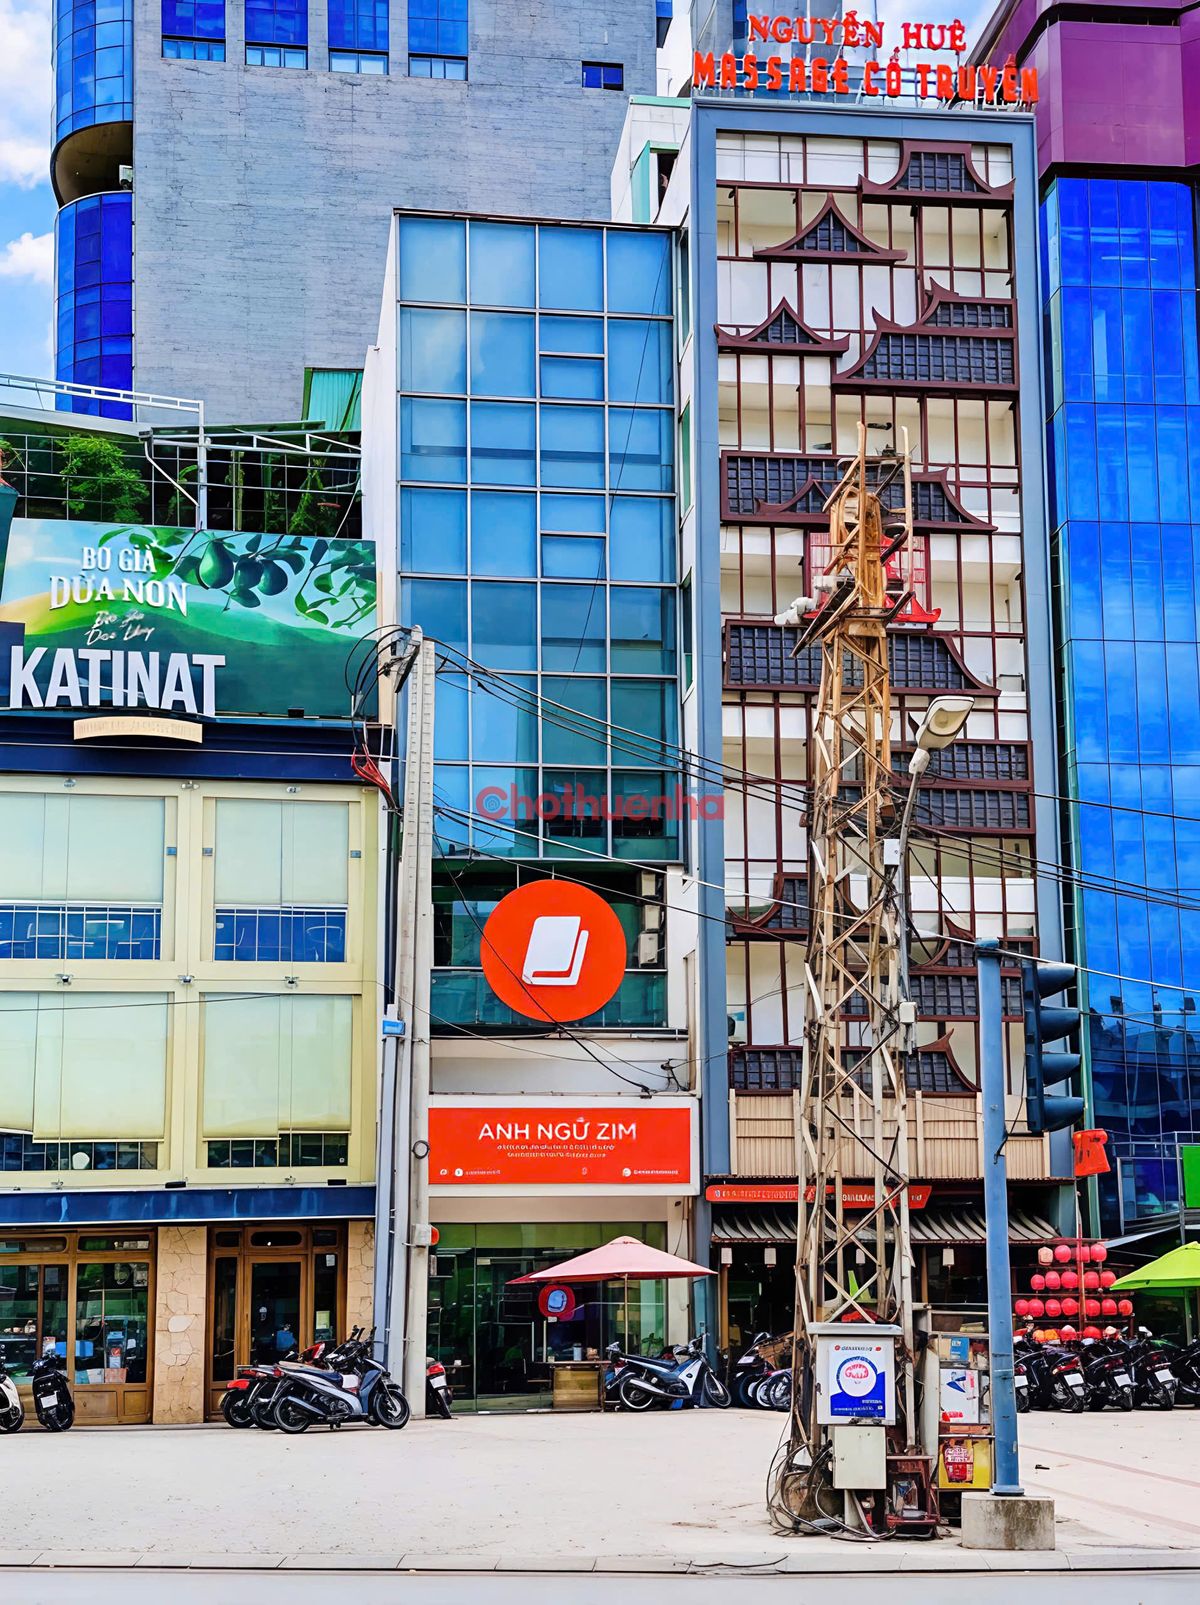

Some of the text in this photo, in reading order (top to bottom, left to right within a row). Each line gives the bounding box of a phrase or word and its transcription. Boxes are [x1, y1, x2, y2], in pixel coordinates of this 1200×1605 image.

[693, 51, 850, 95] MASSAGE
[122, 578, 190, 616] NON
[10, 645, 226, 717] KATINAT
[478, 1123, 530, 1141] ANH
[596, 1123, 637, 1141] ZIM
